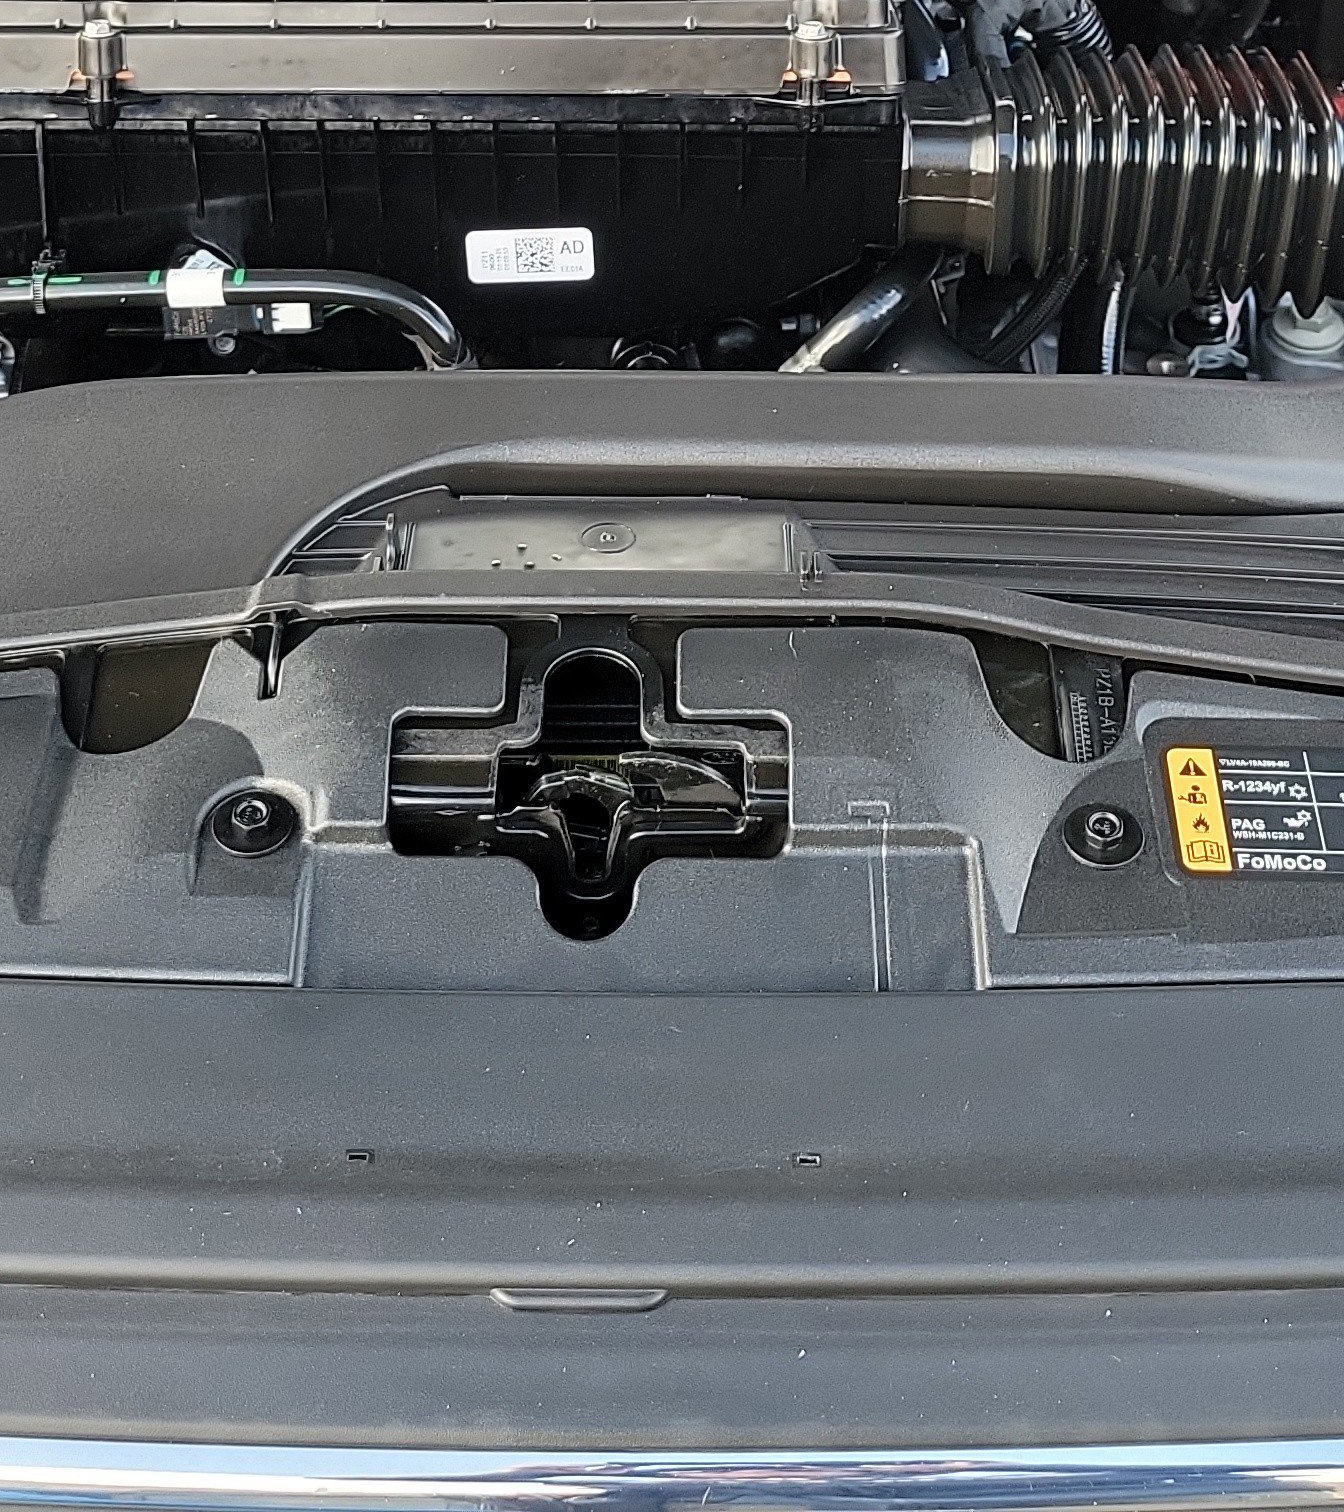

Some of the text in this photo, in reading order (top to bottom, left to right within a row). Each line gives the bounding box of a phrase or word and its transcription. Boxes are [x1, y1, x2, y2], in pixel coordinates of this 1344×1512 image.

[559, 240, 584, 254] AD
[1221, 779, 1287, 796] R-1234yf
[1230, 818, 1266, 831] PAG
[1236, 854, 1327, 871] FoMoCo
